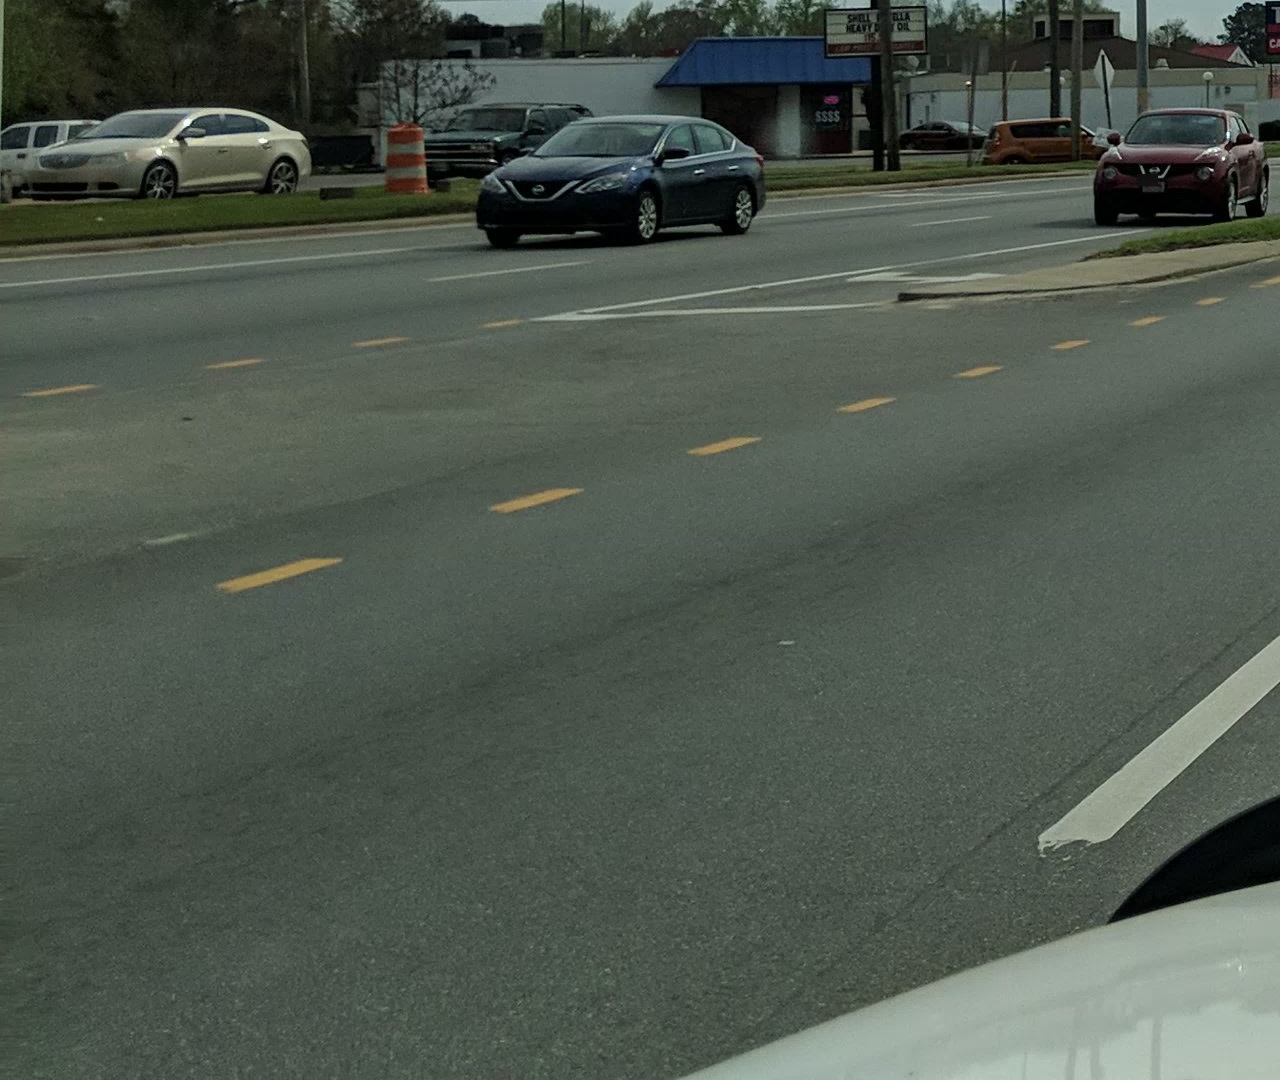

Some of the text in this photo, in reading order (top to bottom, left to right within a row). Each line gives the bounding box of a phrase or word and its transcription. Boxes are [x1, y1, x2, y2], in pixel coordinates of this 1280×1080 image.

[848, 13, 870, 24] SHELL
[846, 23, 872, 33] HEAVY
[897, 22, 912, 32] OIL
